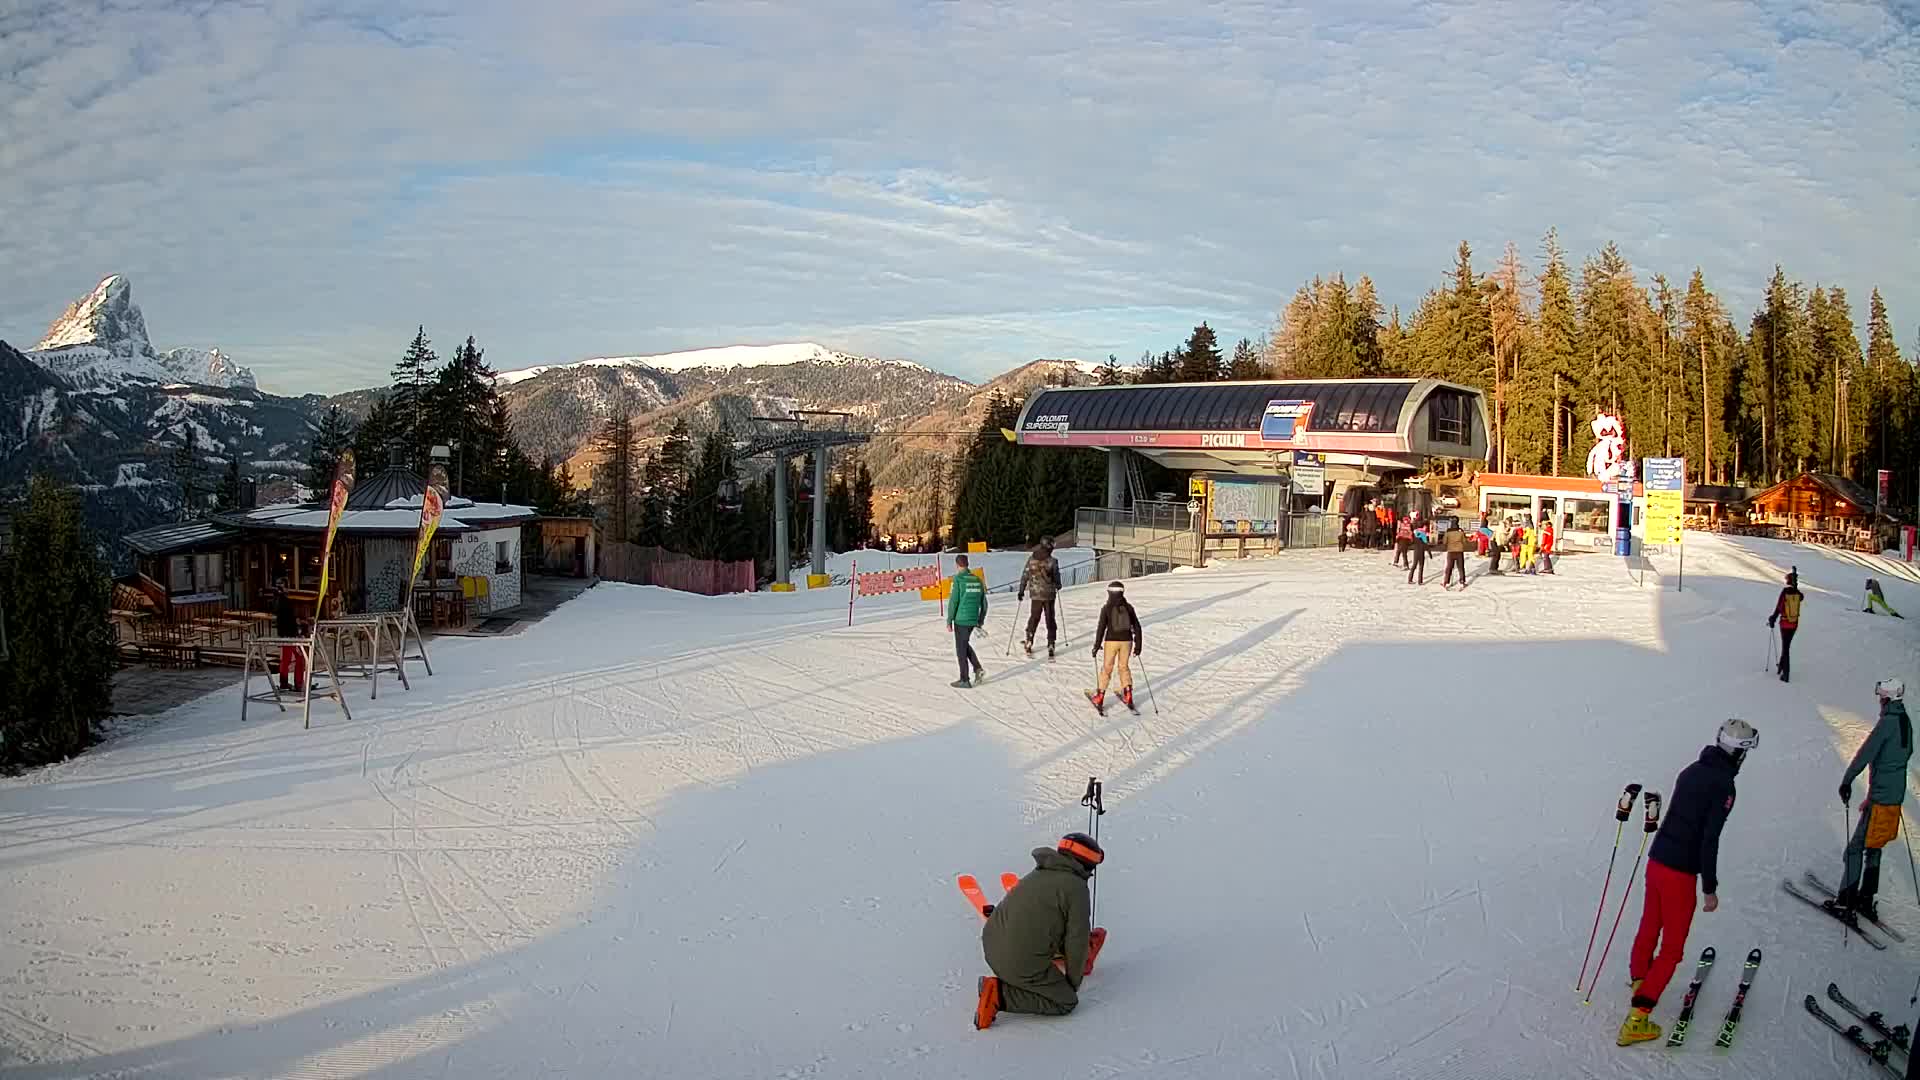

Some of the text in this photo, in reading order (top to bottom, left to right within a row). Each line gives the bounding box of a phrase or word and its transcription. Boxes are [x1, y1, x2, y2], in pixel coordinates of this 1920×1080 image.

[1025, 422, 1058, 430] SUPERSKI
[1201, 434, 1245, 448] PICULIN
[896, 575, 904, 583] 45
